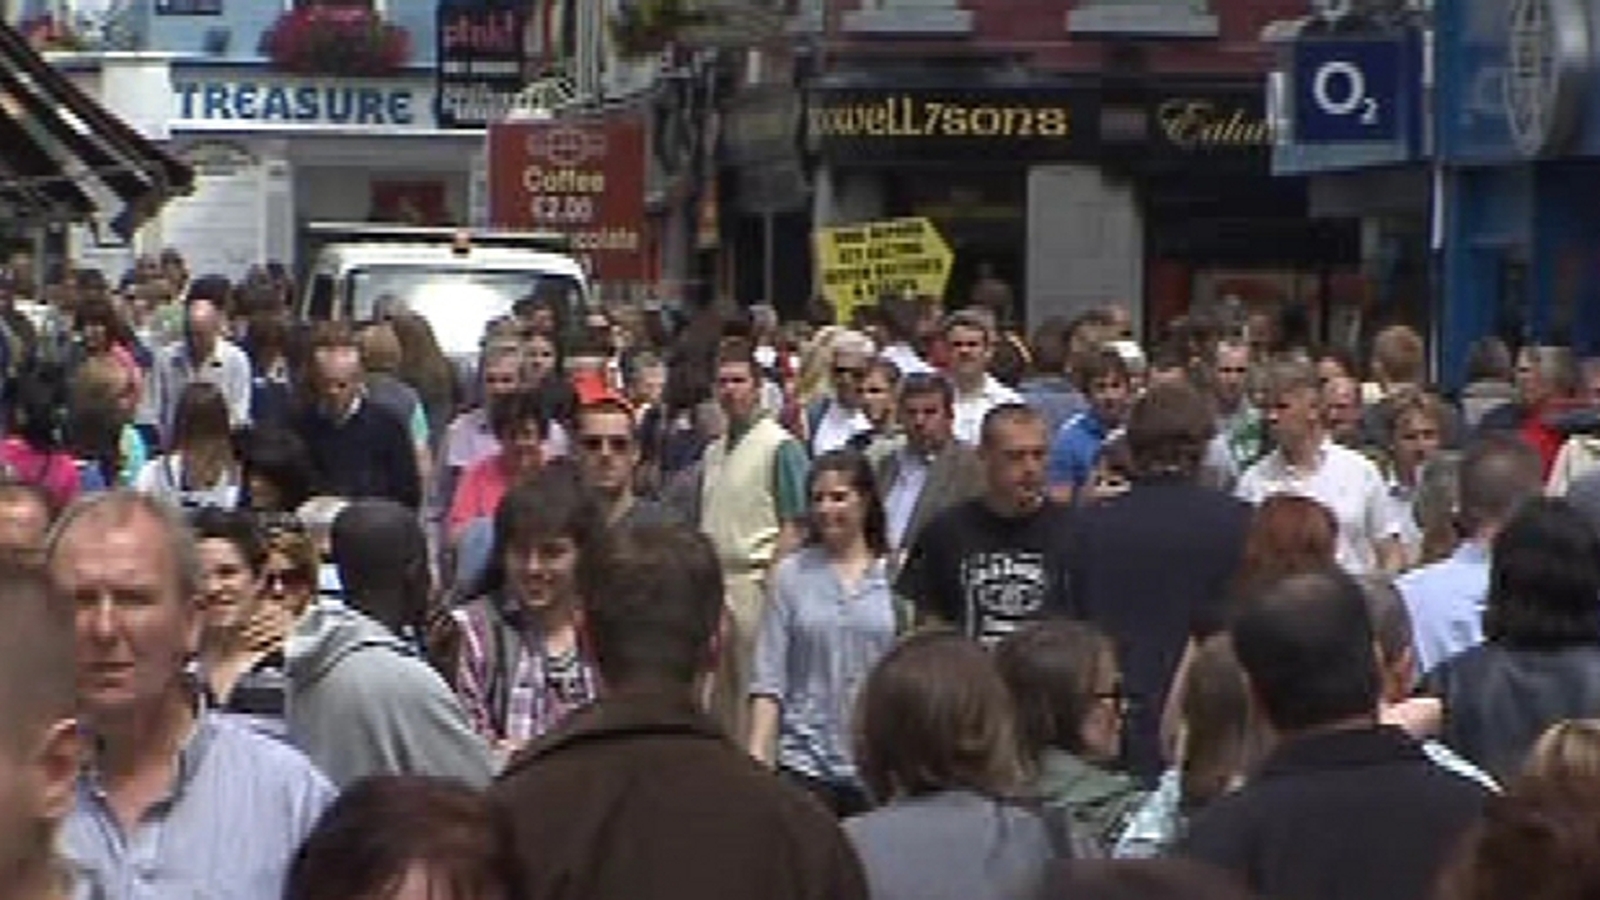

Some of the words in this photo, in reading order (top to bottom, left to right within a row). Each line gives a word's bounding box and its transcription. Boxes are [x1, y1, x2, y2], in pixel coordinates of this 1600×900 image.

[173, 82, 413, 124] TREASURE
[1313, 61, 1379, 125] O2
[522, 164, 606, 193] Coffee
